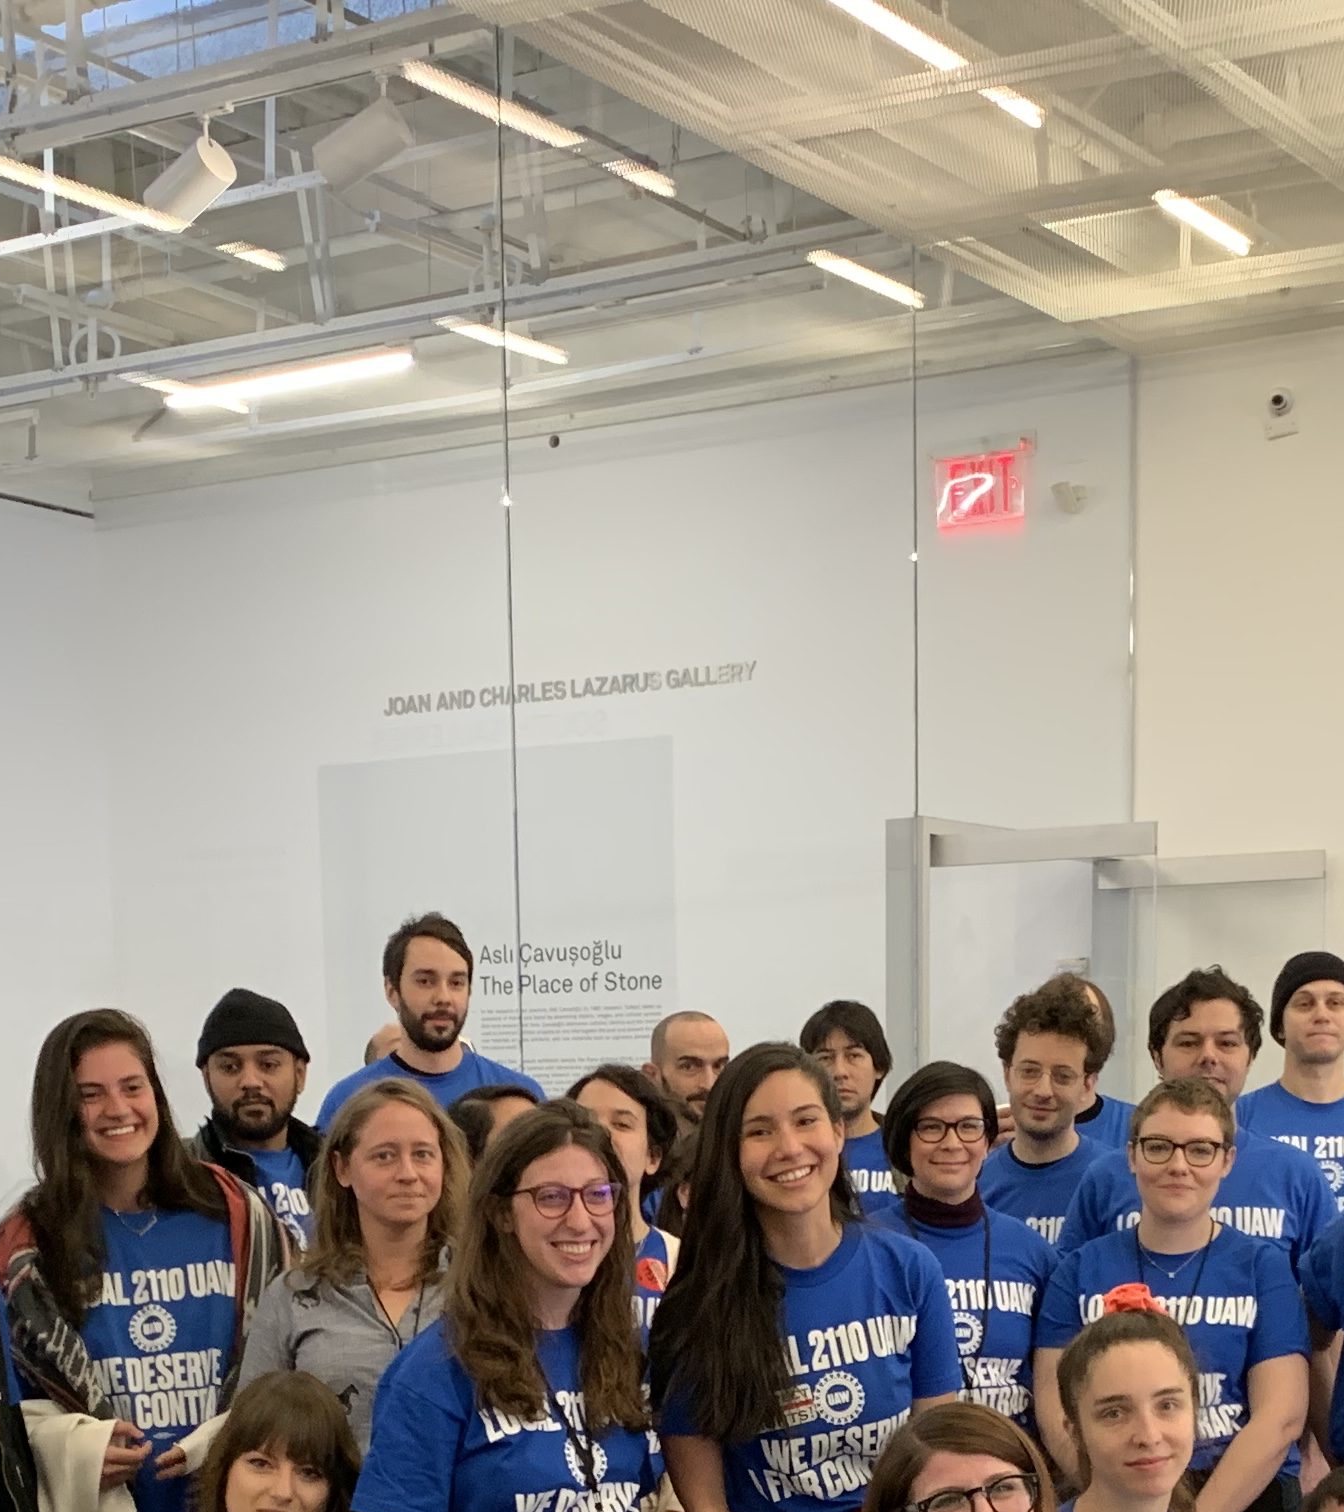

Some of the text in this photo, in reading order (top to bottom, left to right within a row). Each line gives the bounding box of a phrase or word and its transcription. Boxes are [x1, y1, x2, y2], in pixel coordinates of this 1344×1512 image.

[384, 660, 757, 716] JOAN AND CHARLES LAZARUS GALLERY
[480, 940, 623, 968] Aslı Çavuşoğlu
[480, 971, 662, 995] The Place of Stone
[870, 1170, 898, 1195] UA
[1236, 1206, 1286, 1239] UAW
[131, 1267, 186, 1305] 2110
[187, 1260, 236, 1298] UAW
[993, 1280, 1036, 1316] UAW
[1205, 1296, 1258, 1329] UAW
[808, 1321, 870, 1373] 2110
[126, 1349, 222, 1394] DESERVE
[827, 1389, 850, 1407] UAW
[760, 1437, 809, 1474] WE
